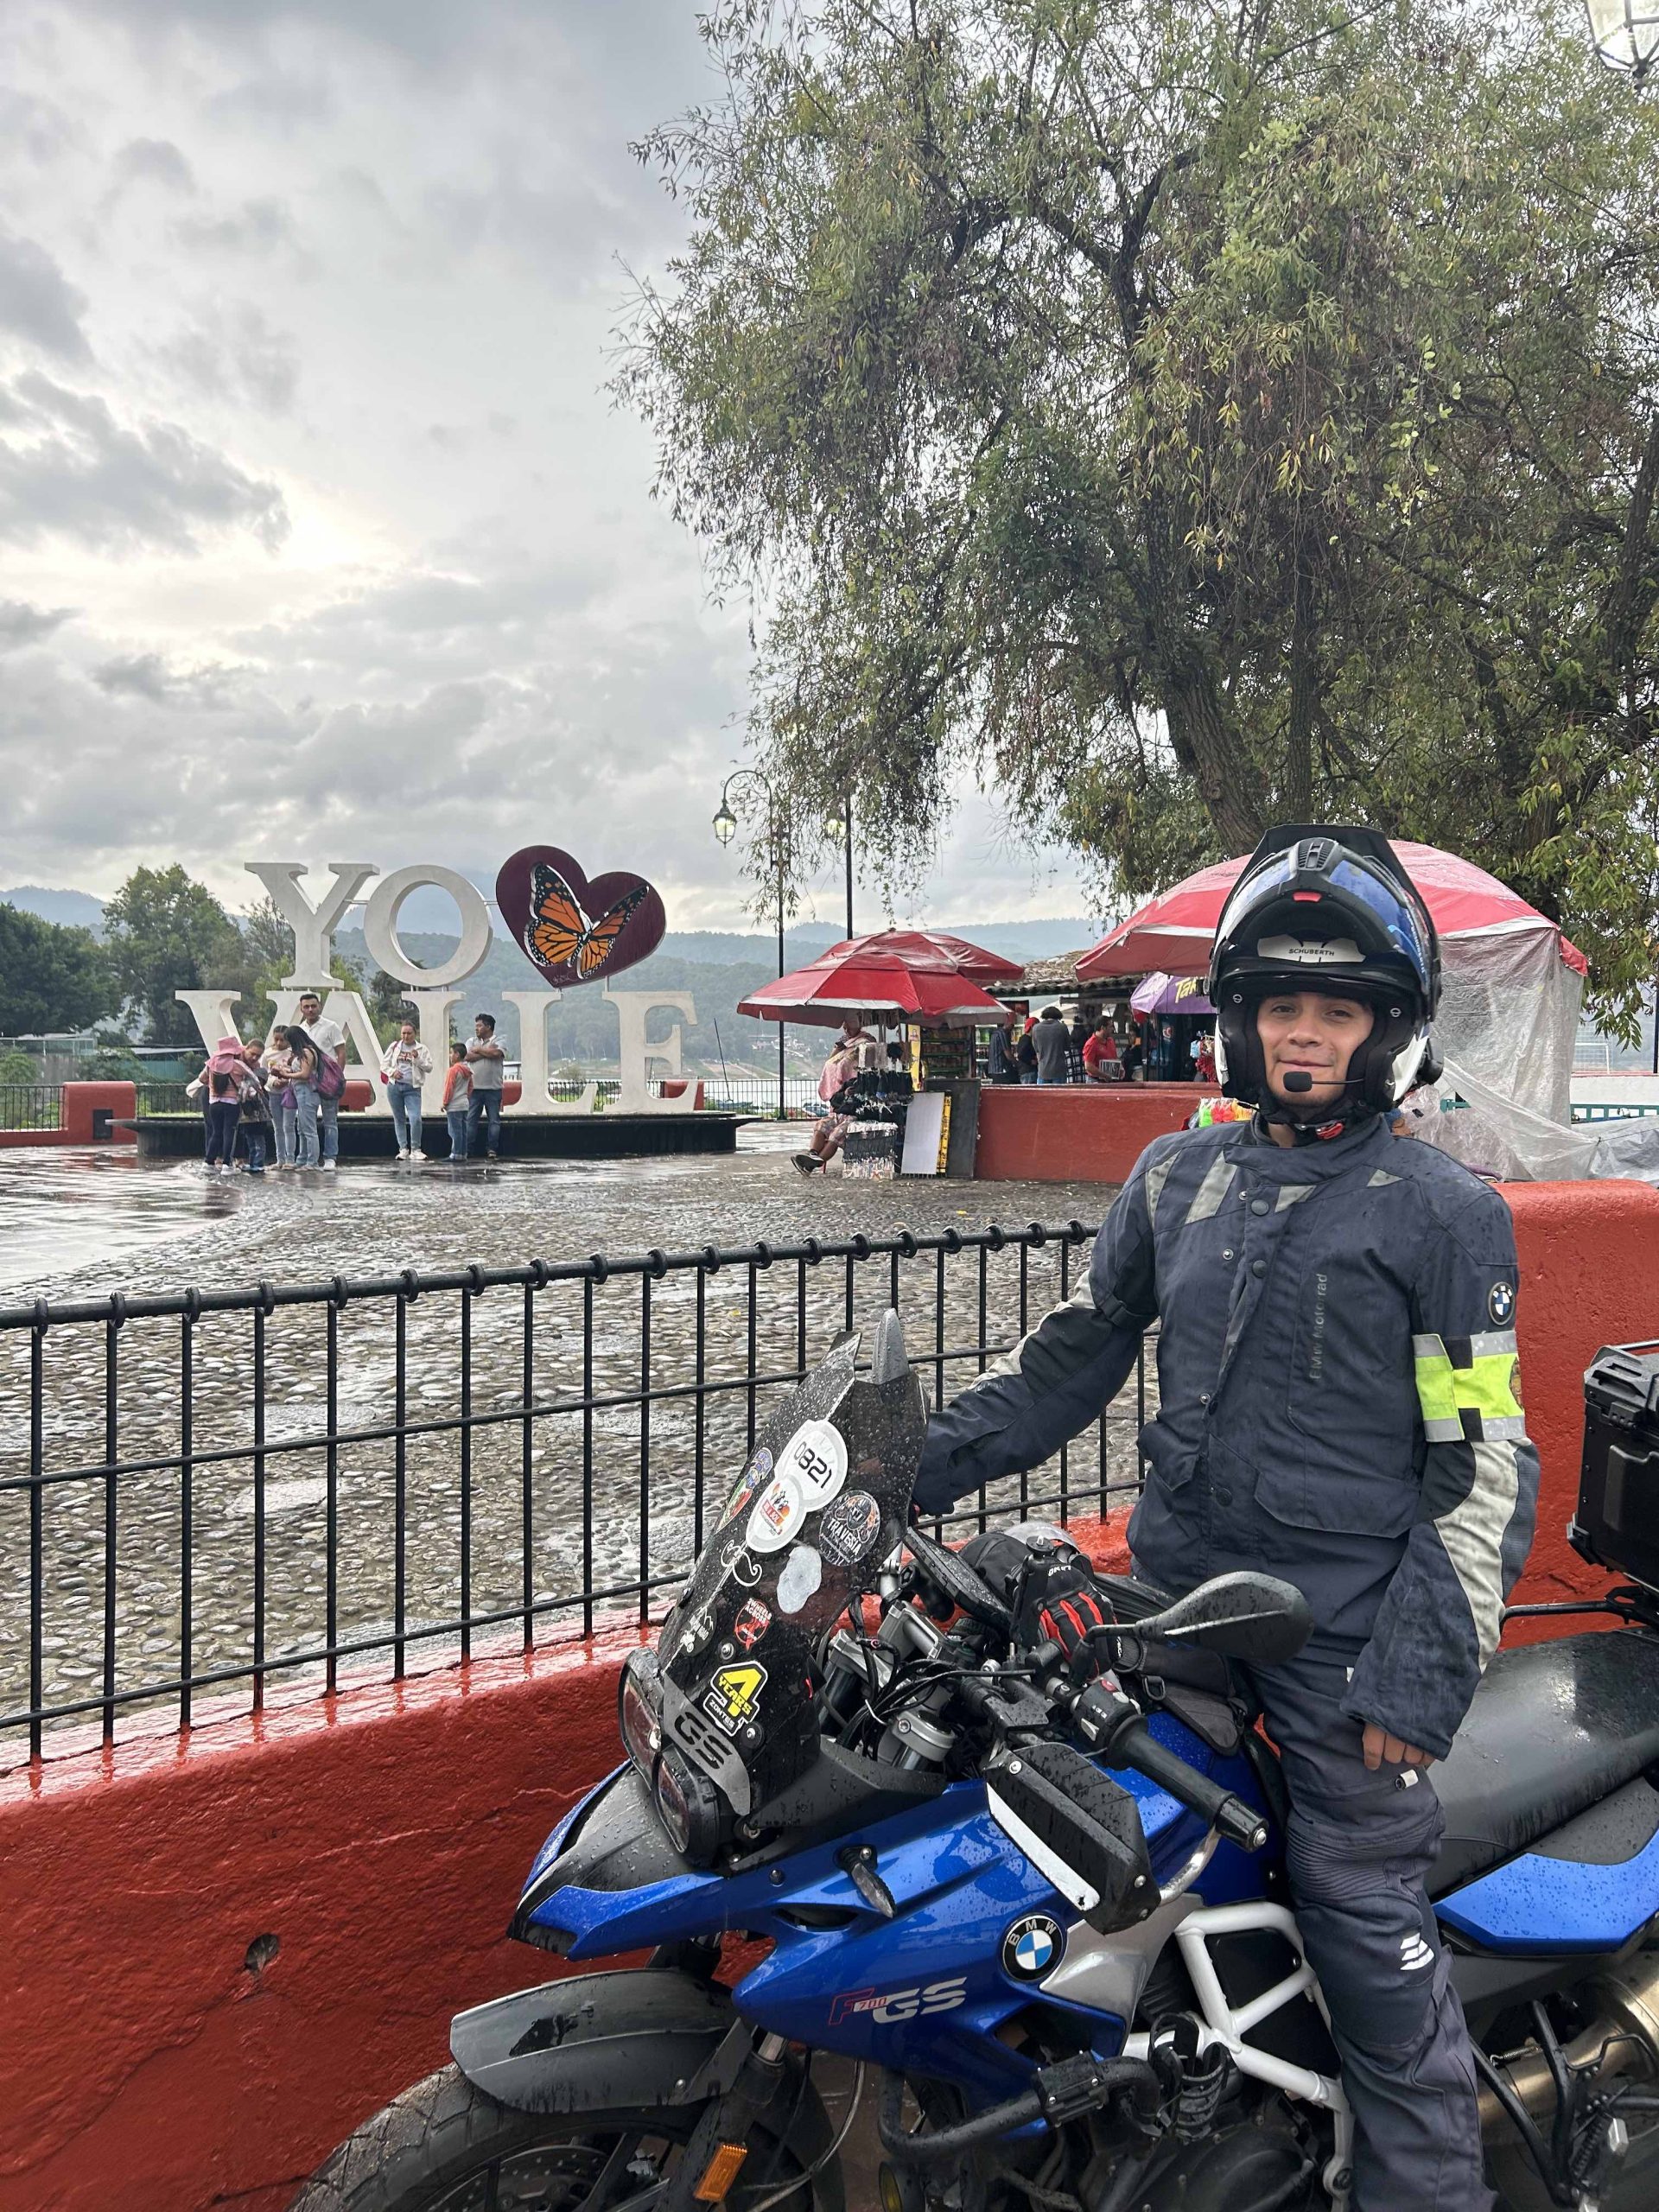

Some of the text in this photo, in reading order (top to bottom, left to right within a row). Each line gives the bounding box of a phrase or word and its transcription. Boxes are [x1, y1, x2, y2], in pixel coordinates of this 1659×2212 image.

[245, 862, 493, 988] YO
[793, 1441, 832, 1489] 0821
[827, 1518, 862, 1555] TRAVESIA
[744, 1605, 766, 1624] ACROSS
[719, 1675, 753, 1716] YEARS
[721, 1669, 762, 1717] 4
[709, 1699, 735, 1729] ZONTES
[674, 1712, 733, 1770] GS
[1008, 1918, 1057, 1947] BMW
